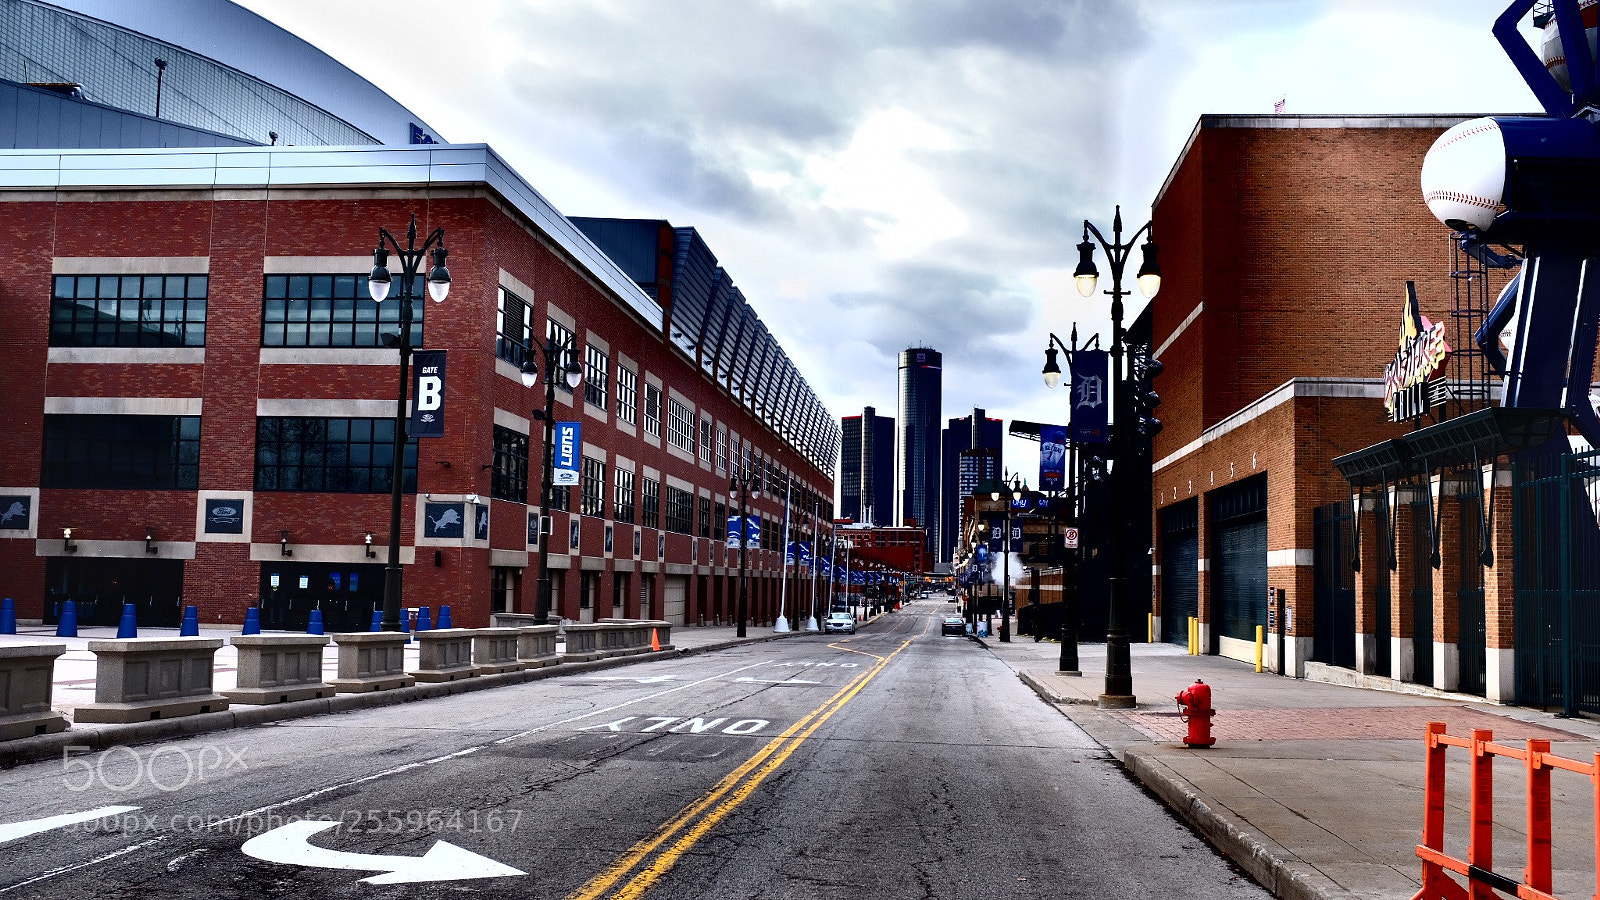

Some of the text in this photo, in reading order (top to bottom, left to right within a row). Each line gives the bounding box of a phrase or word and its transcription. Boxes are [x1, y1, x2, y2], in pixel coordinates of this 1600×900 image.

[410, 122, 439, 144] Fo
[422, 366, 438, 374] GATE
[418, 376, 442, 411] B
[1393, 382, 1424, 423] GRILL
[561, 426, 574, 467] LIONS
[1252, 451, 1257, 470] 6
[575, 716, 770, 735] ONLY
